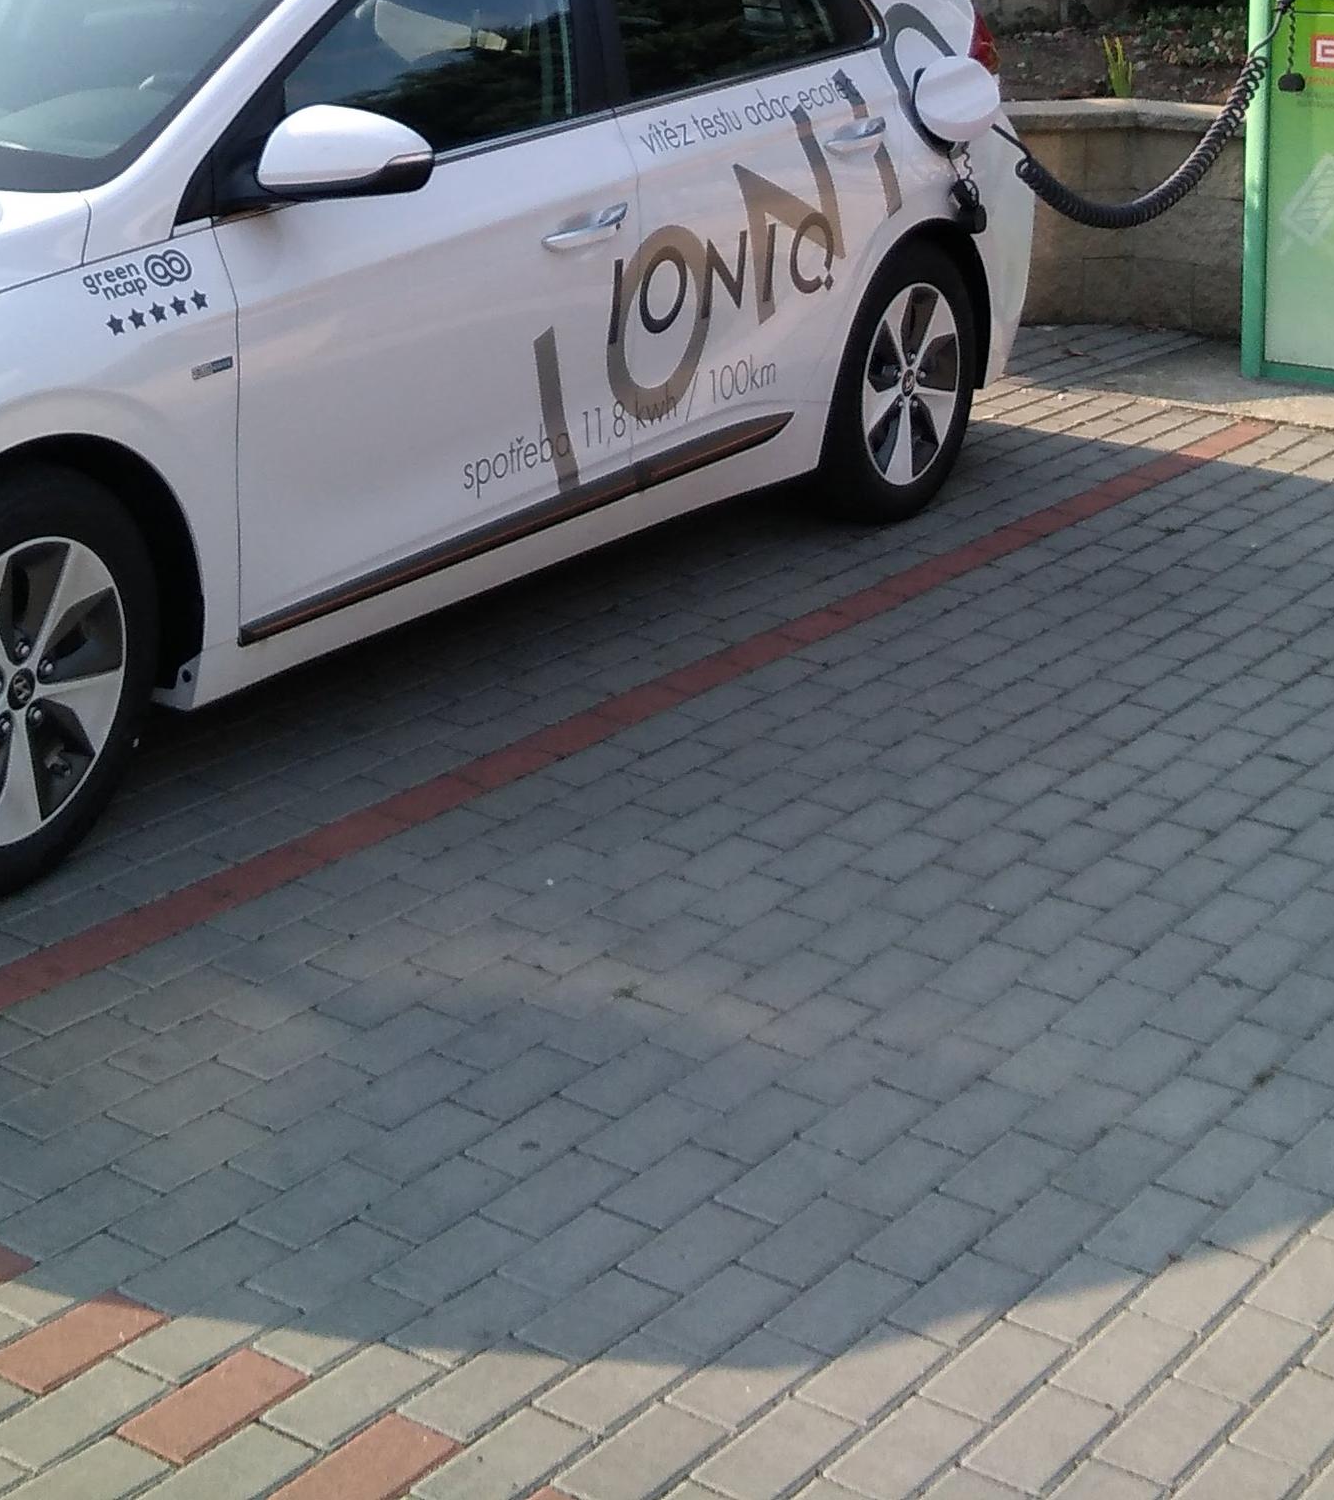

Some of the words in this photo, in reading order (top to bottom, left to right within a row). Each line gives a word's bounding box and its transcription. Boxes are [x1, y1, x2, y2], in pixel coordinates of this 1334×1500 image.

[638, 119, 696, 156] vítěz
[691, 107, 742, 141] testu
[744, 88, 794, 127] adac
[82, 260, 139, 296] green
[102, 275, 148, 301] ncap
[606, 211, 835, 346] IONIQ
[463, 423, 572, 499] spotřeba
[582, 400, 627, 449] 11,8
[708, 354, 777, 404] 100km
